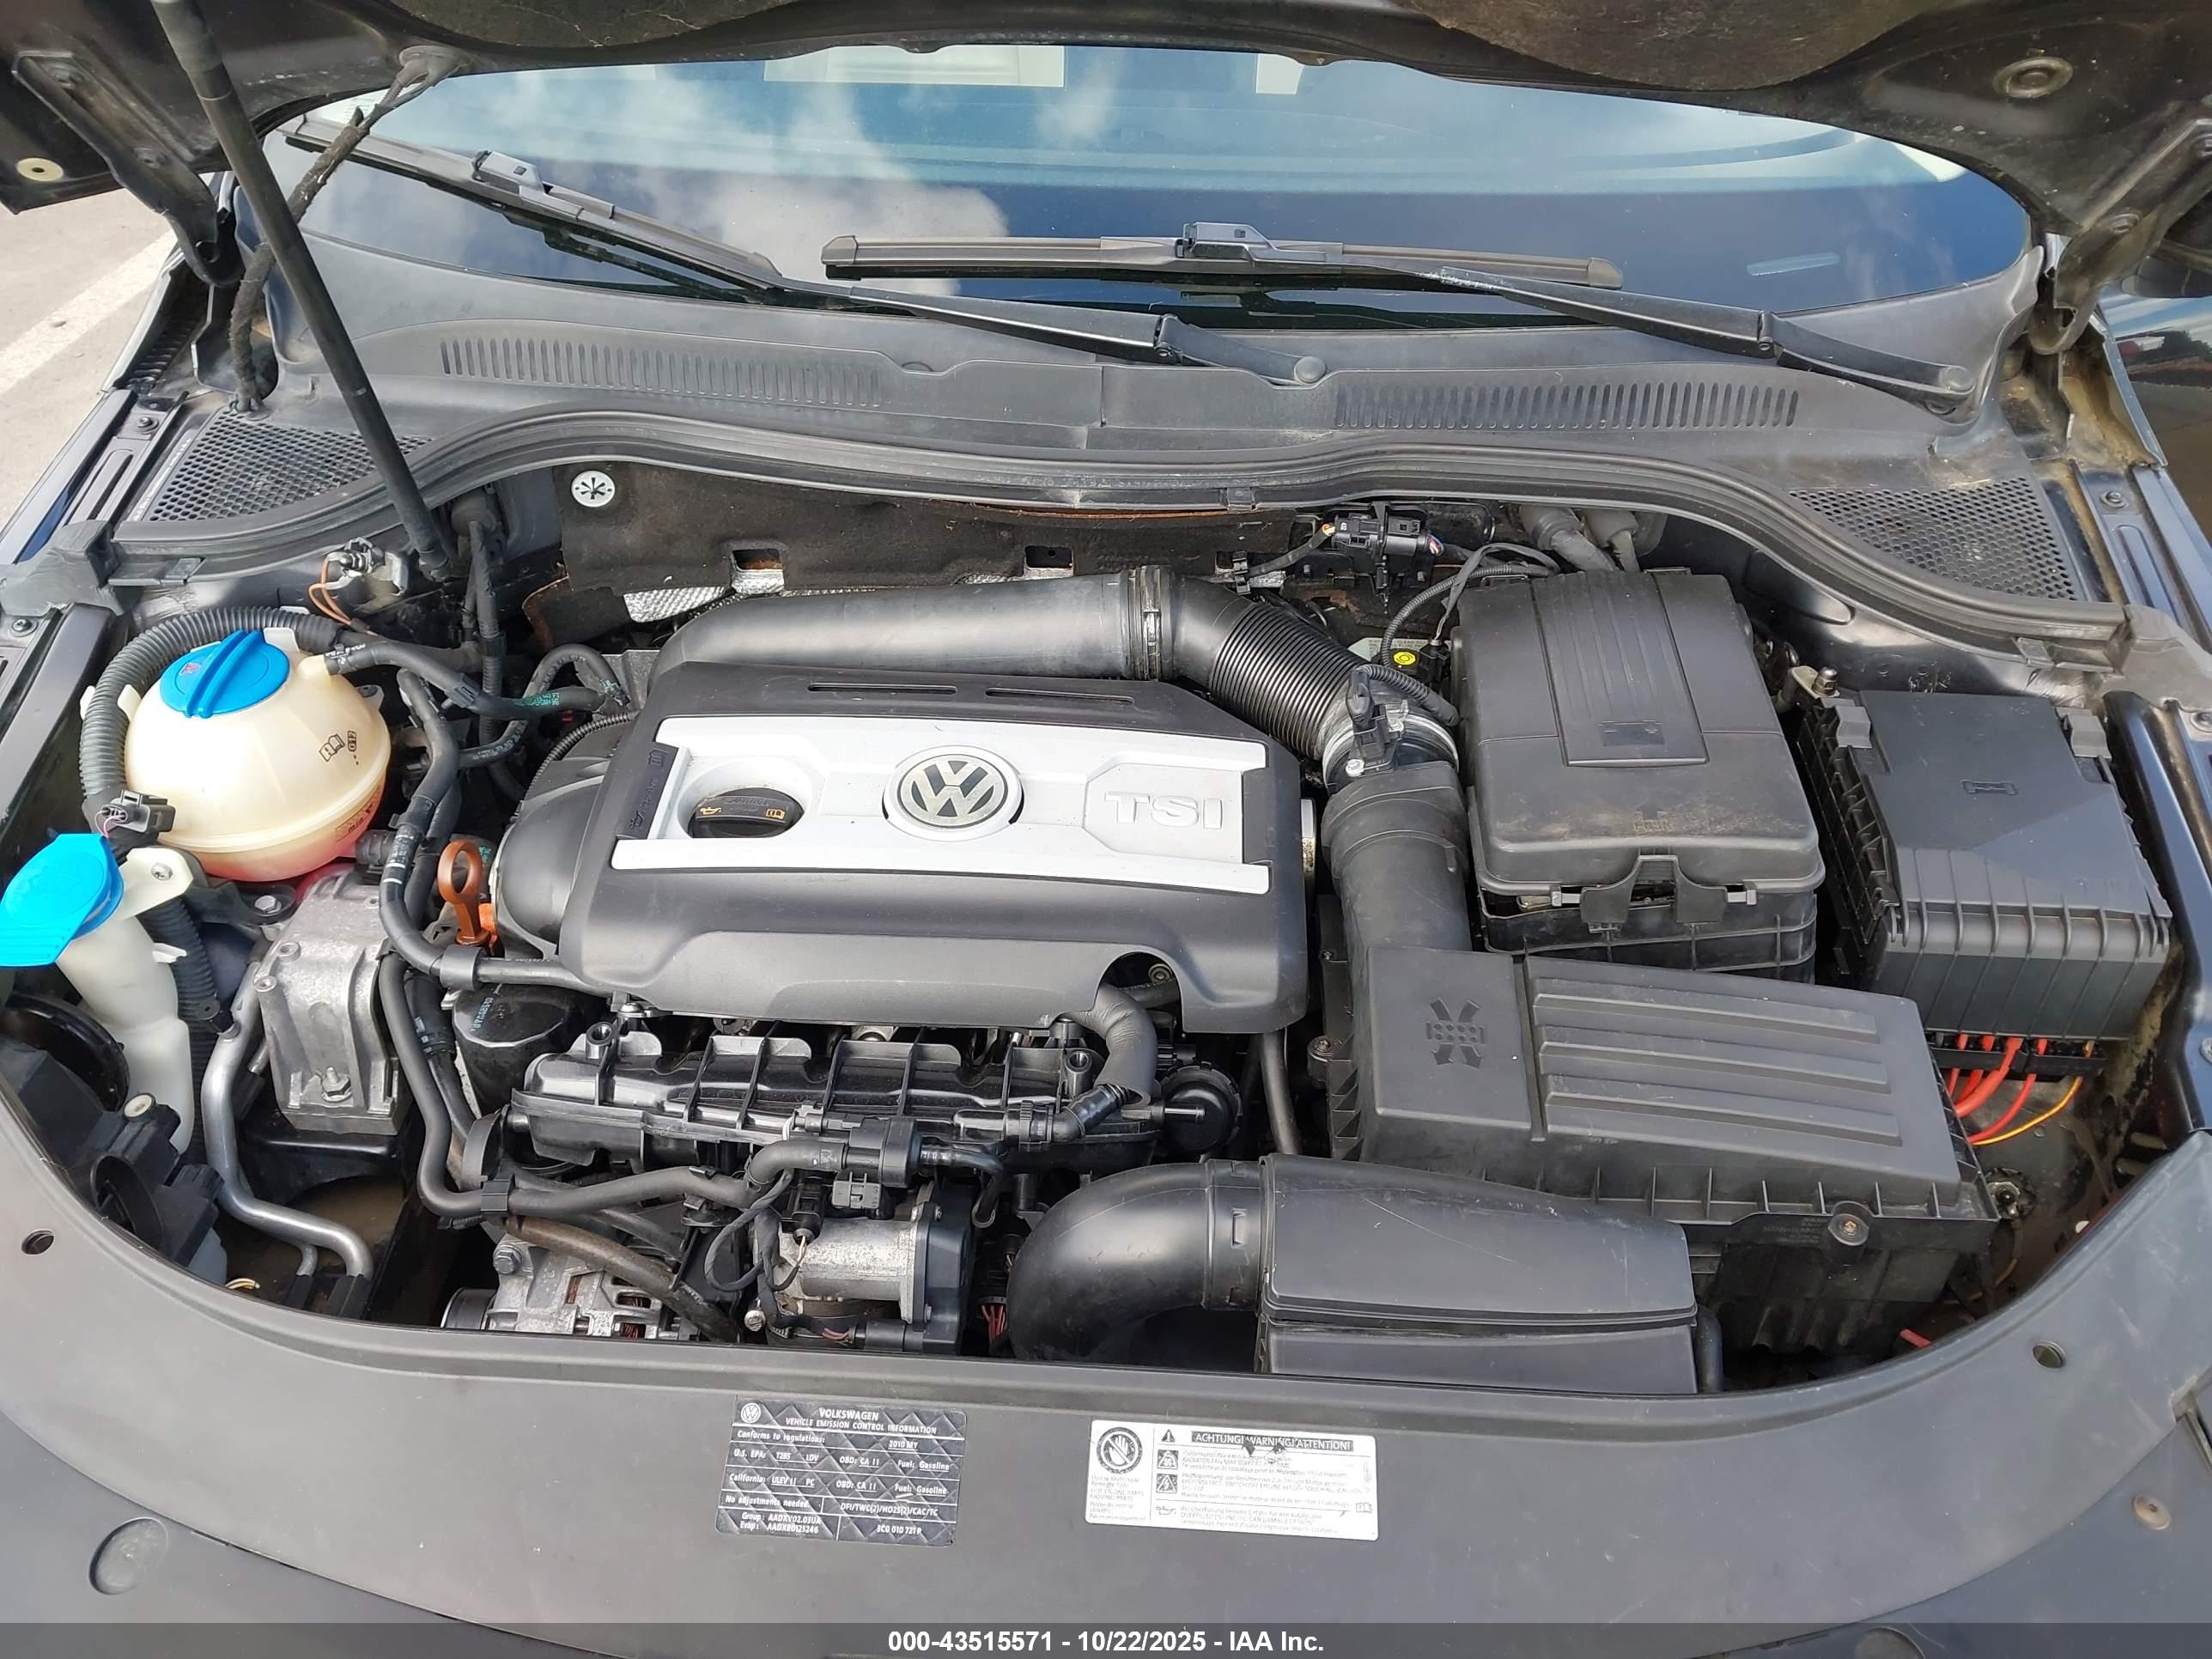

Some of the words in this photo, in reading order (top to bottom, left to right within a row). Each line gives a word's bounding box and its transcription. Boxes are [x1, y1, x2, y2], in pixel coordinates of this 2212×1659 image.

[1103, 791, 1224, 830] TSI
[818, 1407, 879, 1421] VOLKSWAGEN
[786, 1417, 814, 1427] VEHICLE
[816, 1419, 850, 1429] EMISSION
[852, 1422, 885, 1431] CONTROL
[887, 1424, 937, 1434] INFORMATION
[737, 1430, 770, 1440] Conforms
[772, 1431, 781, 1440] to
[783, 1433, 825, 1443] regulations:
[888, 1440, 906, 1449] 2010
[1195, 1432, 1244, 1444] ACHTUNG!
[1297, 1438, 1351, 1451] ATTENTION!
[733, 1448, 748, 1457] U.S.
[750, 1449, 767, 1459] EPA:
[805, 1453, 819, 1462] LDV
[839, 1455, 857, 1464] OBD:
[897, 1460, 915, 1468] Fuel:
[920, 1461, 950, 1471] Gasoline
[730, 1473, 766, 1483] California:
[771, 1476, 788, 1486] ULEV
[805, 1478, 815, 1486] PC
[836, 1480, 854, 1489] OBD:
[894, 1483, 912, 1492] Fuel:
[916, 1486, 947, 1495] Gasoline
[725, 1495, 736, 1504] No
[738, 1496, 781, 1507] adjustments
